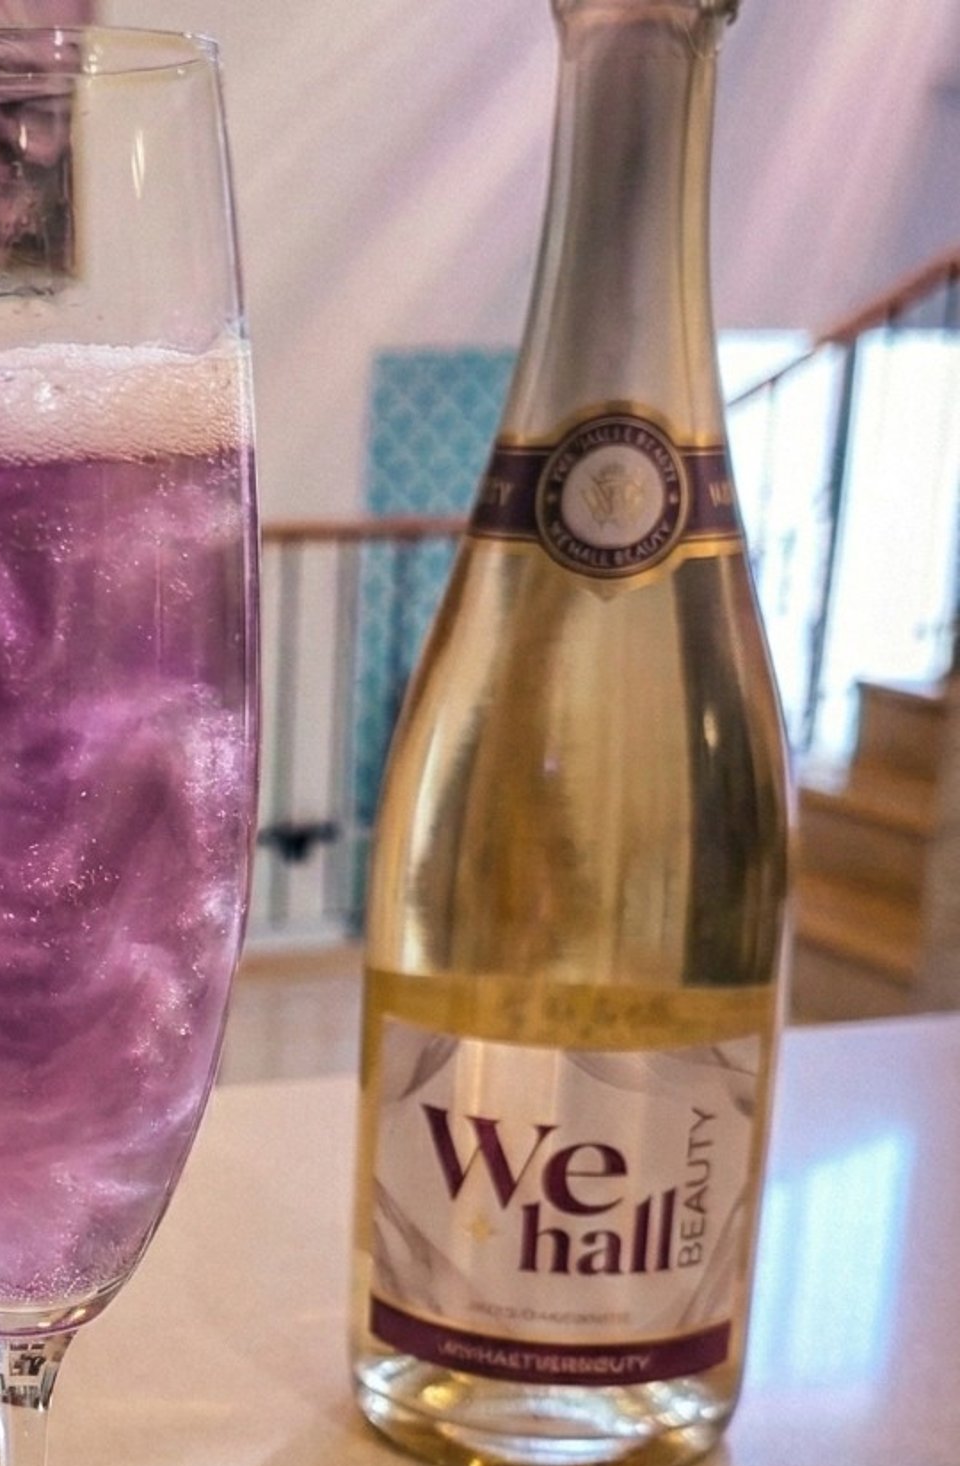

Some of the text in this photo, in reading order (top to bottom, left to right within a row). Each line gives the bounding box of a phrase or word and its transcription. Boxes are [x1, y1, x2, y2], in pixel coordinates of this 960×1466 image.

[421, 1102, 629, 1217] We
[678, 1106, 717, 1269] BEAUTY
[518, 1187, 678, 1276] hall
